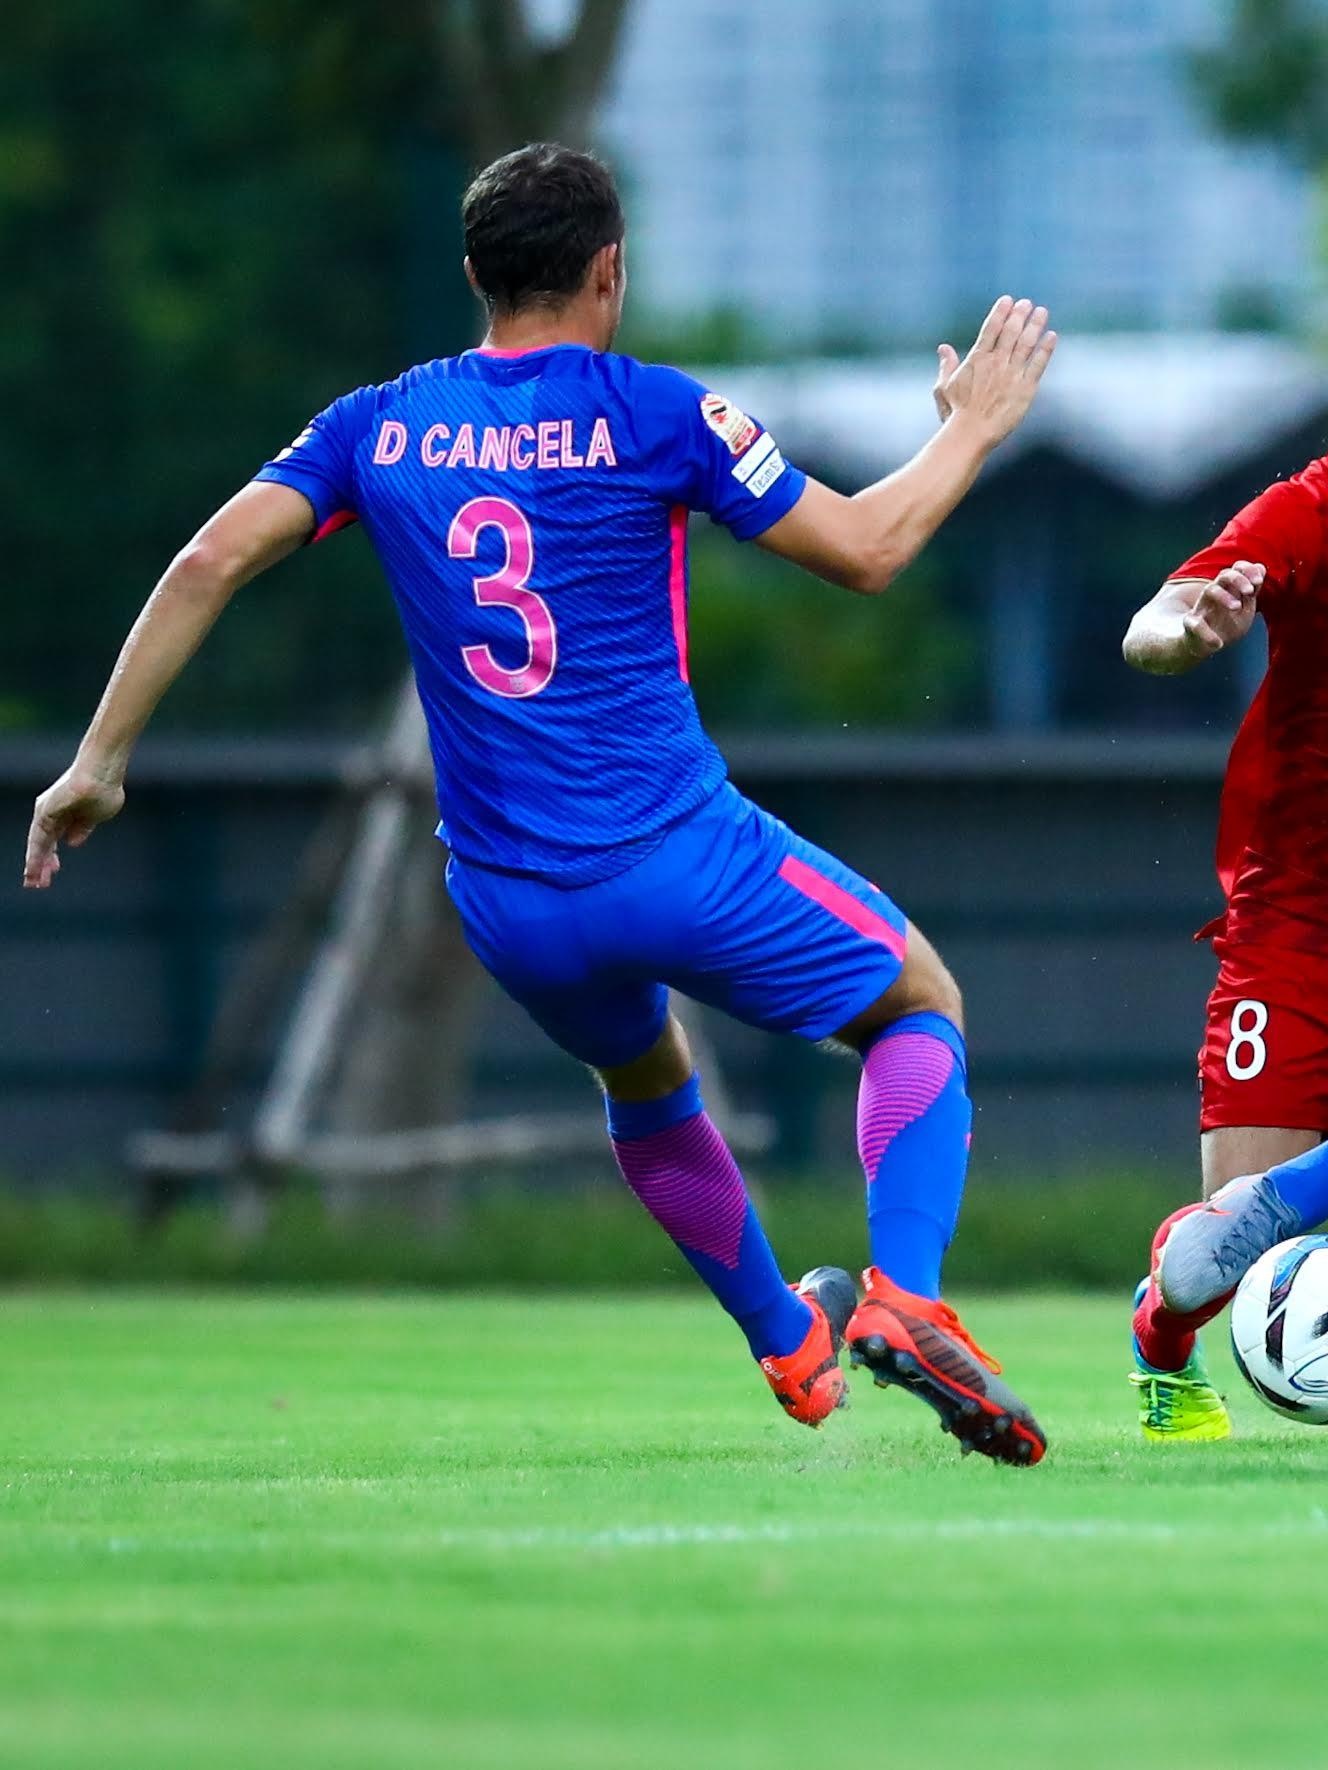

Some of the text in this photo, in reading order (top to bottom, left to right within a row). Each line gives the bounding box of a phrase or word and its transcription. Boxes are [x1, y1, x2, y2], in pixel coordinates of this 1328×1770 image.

[373, 420, 408, 465] D
[421, 417, 617, 472] CANCELA
[448, 496, 556, 698] 3
[1226, 1000, 1268, 1081] 8
